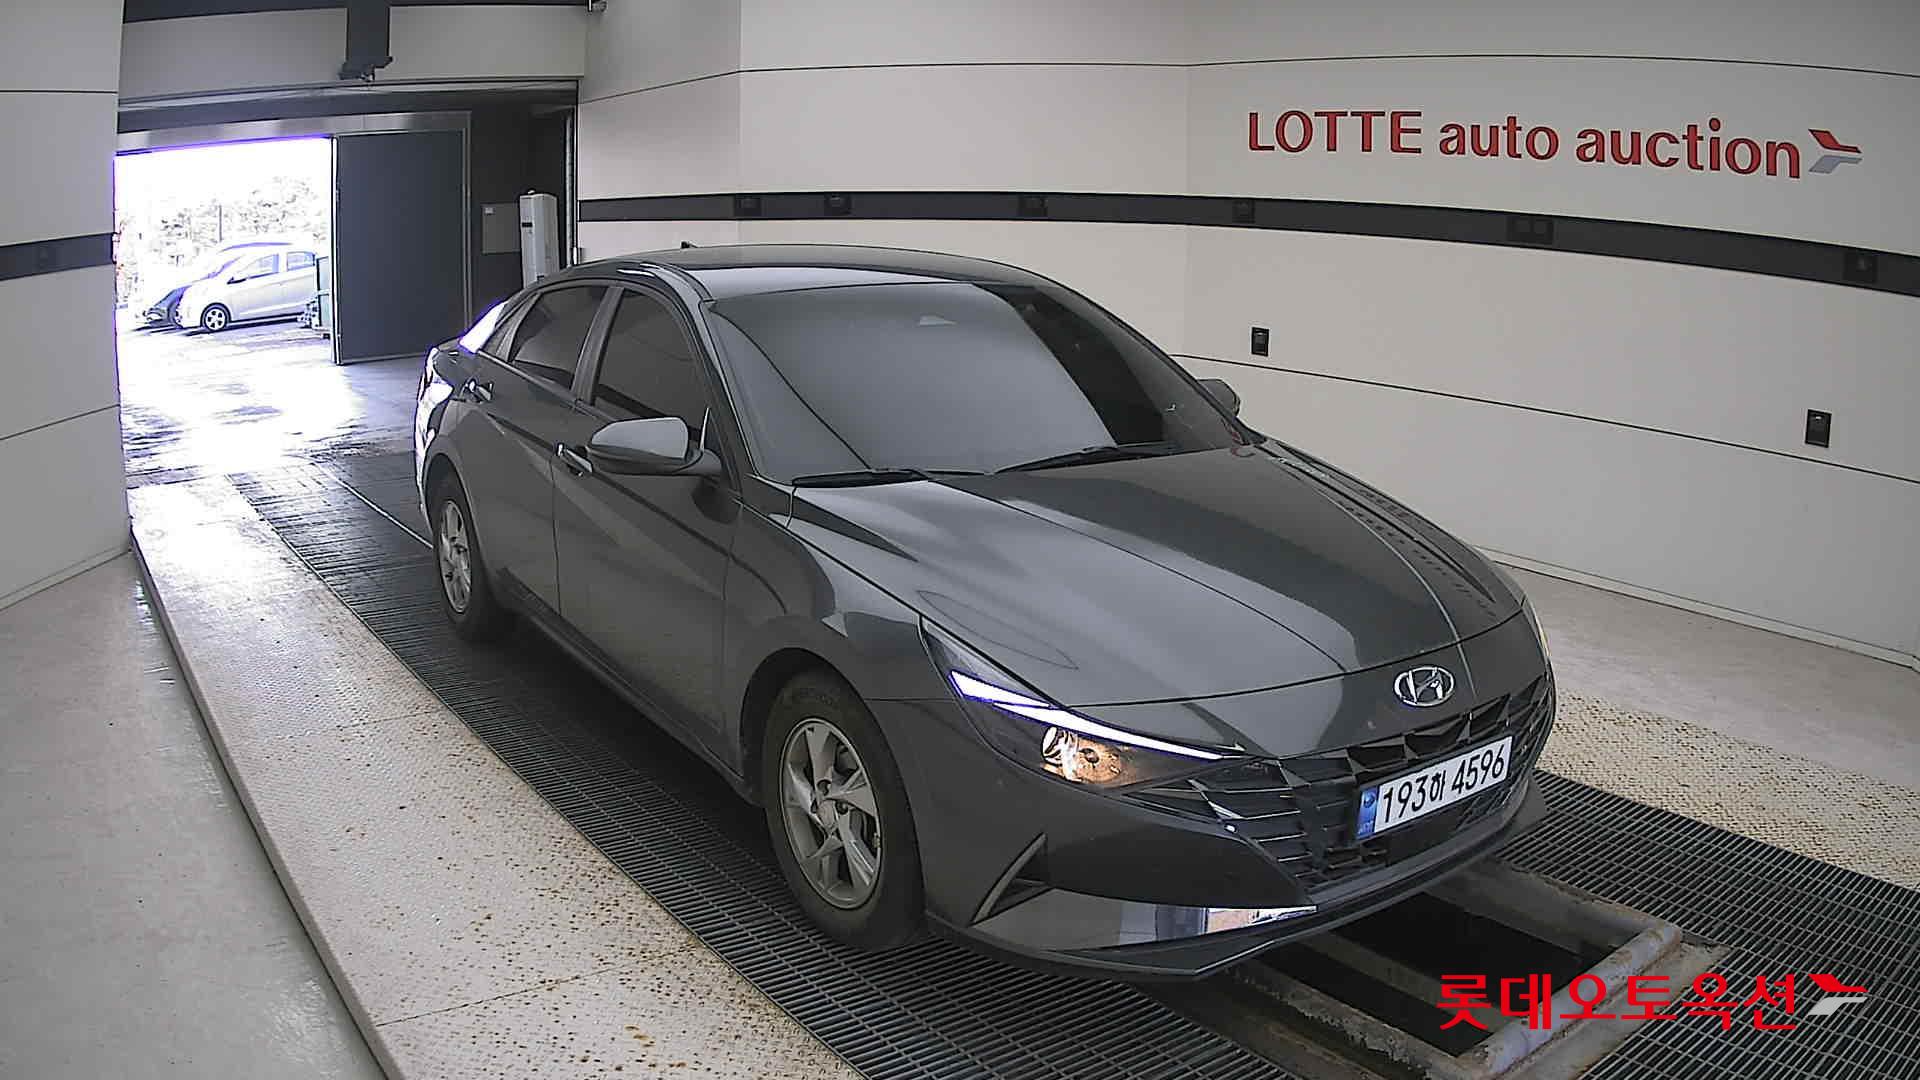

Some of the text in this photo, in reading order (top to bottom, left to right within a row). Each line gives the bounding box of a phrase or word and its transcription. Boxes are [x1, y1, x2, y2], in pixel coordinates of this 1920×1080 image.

[1249, 110, 1801, 178] LOTTE auto auction
[1383, 744, 1505, 823] 193하 4596
